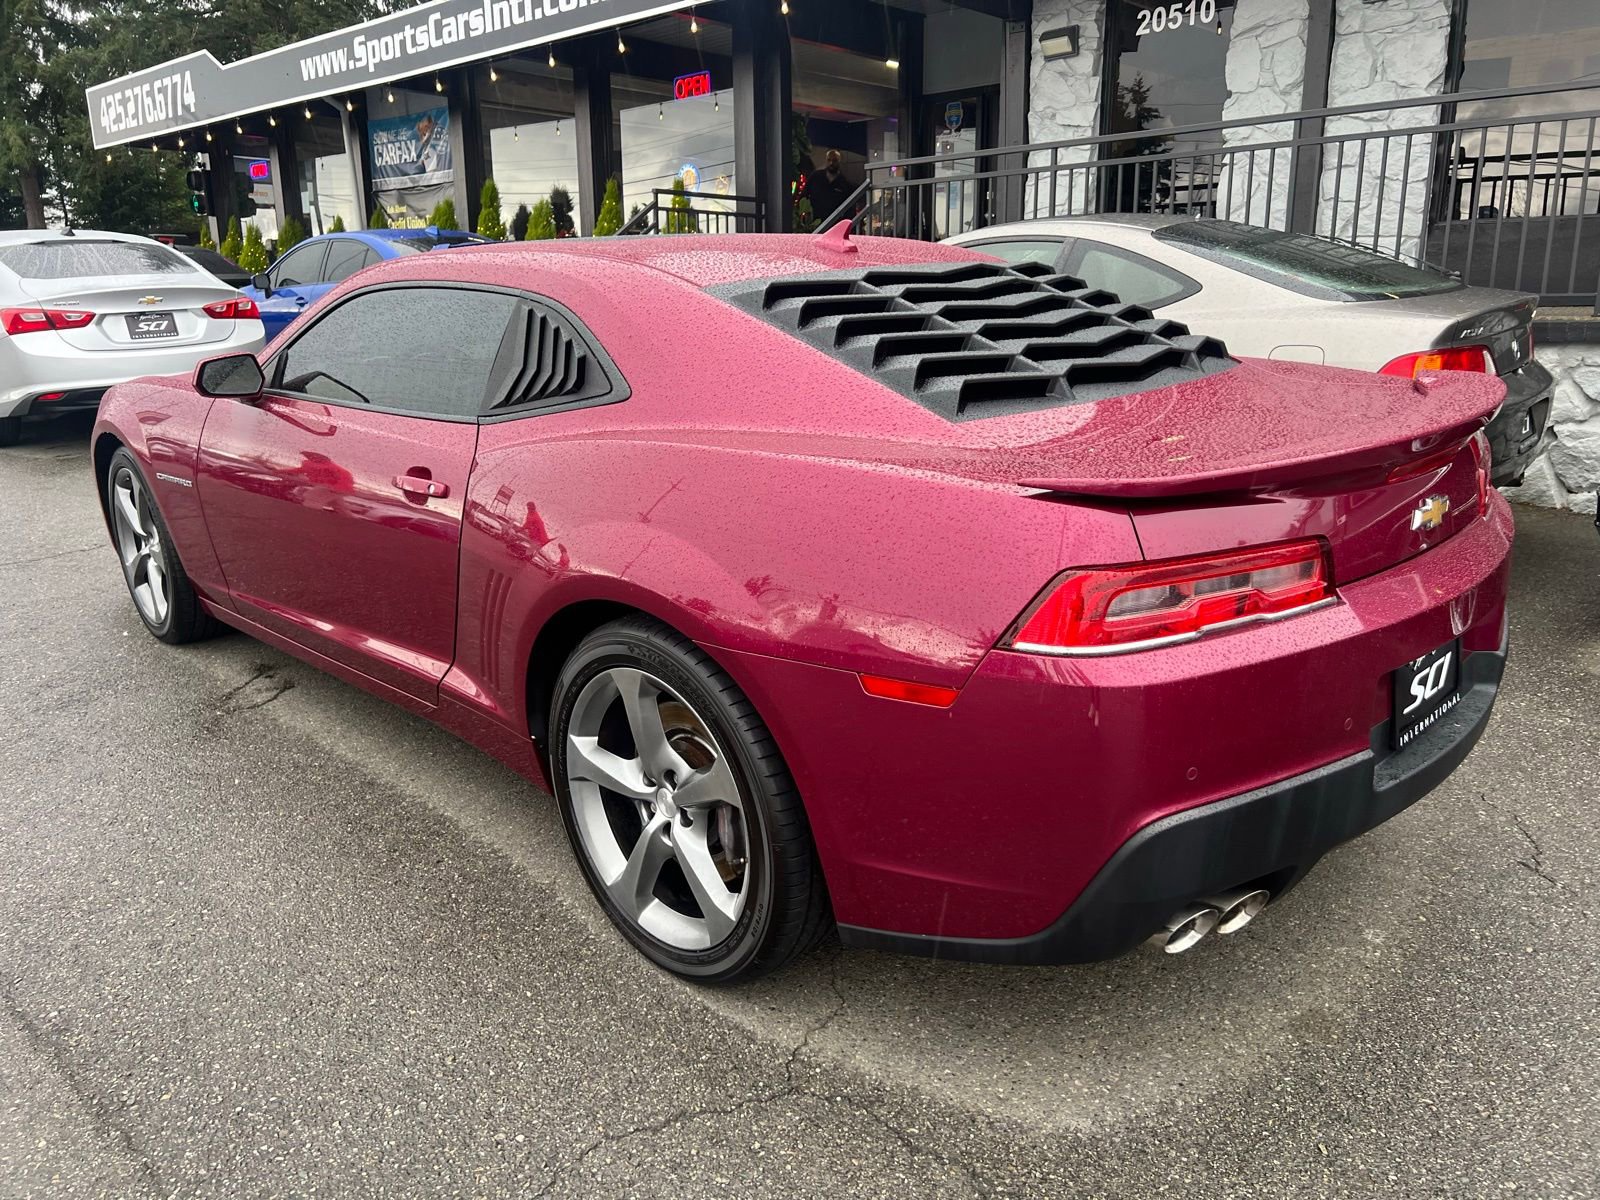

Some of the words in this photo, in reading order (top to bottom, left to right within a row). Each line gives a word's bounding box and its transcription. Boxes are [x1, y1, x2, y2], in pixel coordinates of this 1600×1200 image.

[299, 0, 606, 81] www.SportsCarsIntl.c
[1135, 0, 1216, 36] 20510
[100, 70, 196, 134] 425.276.6774
[675, 74, 709, 100] OPEN
[374, 140, 417, 167] CARFAX
[135, 320, 169, 332] SCI
[1402, 651, 1452, 715] SCI
[1399, 692, 1461, 747] INTERNATIONAL
